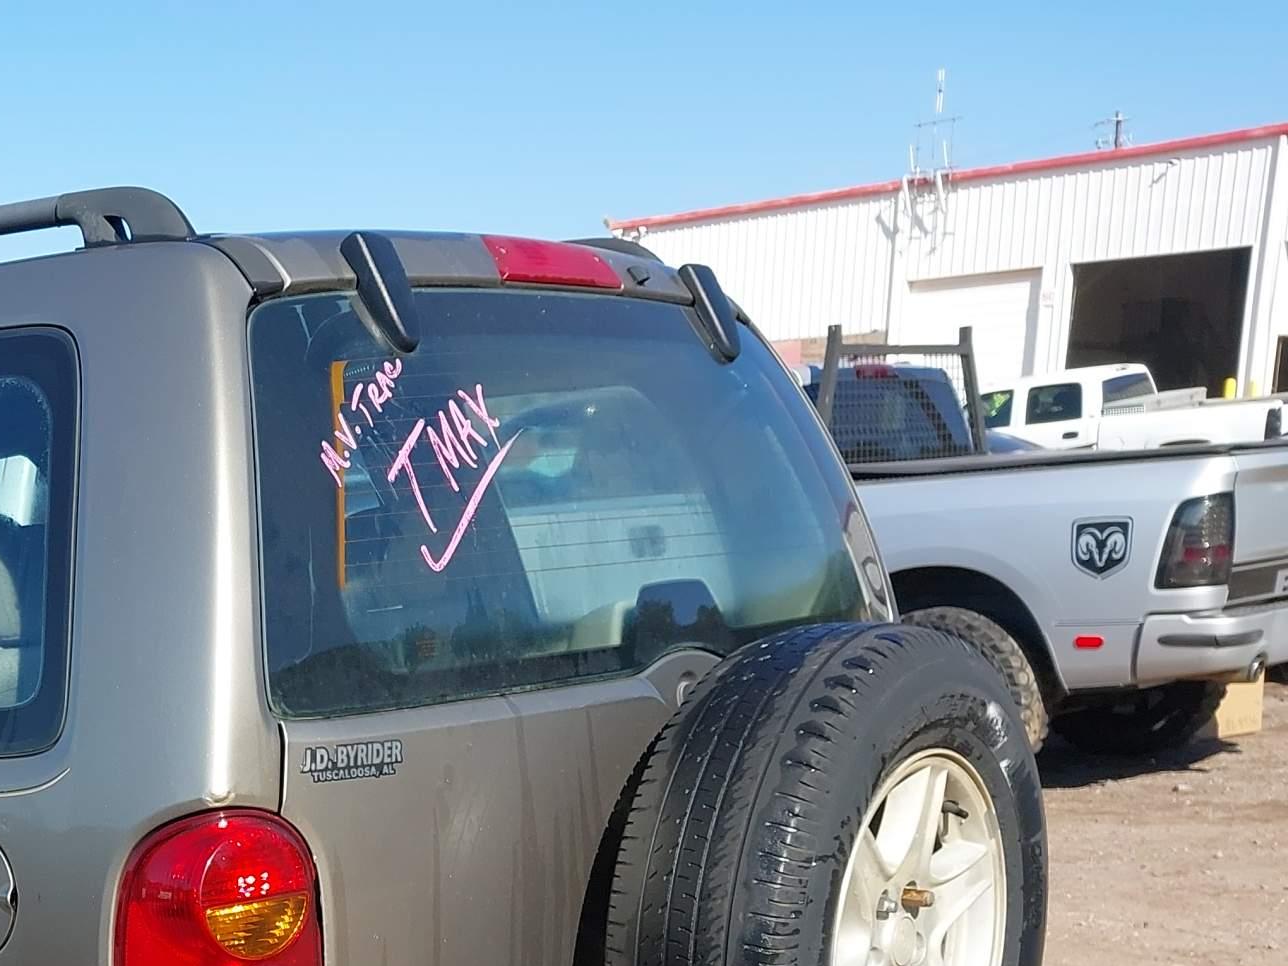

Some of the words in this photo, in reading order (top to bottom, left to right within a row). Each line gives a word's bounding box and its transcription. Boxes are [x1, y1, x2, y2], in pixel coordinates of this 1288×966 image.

[302, 748, 332, 772] J.D.
[336, 740, 402, 768] BYRIDER
[312, 765, 380, 782] TUSCALOOSA,
[382, 763, 395, 775] AL
